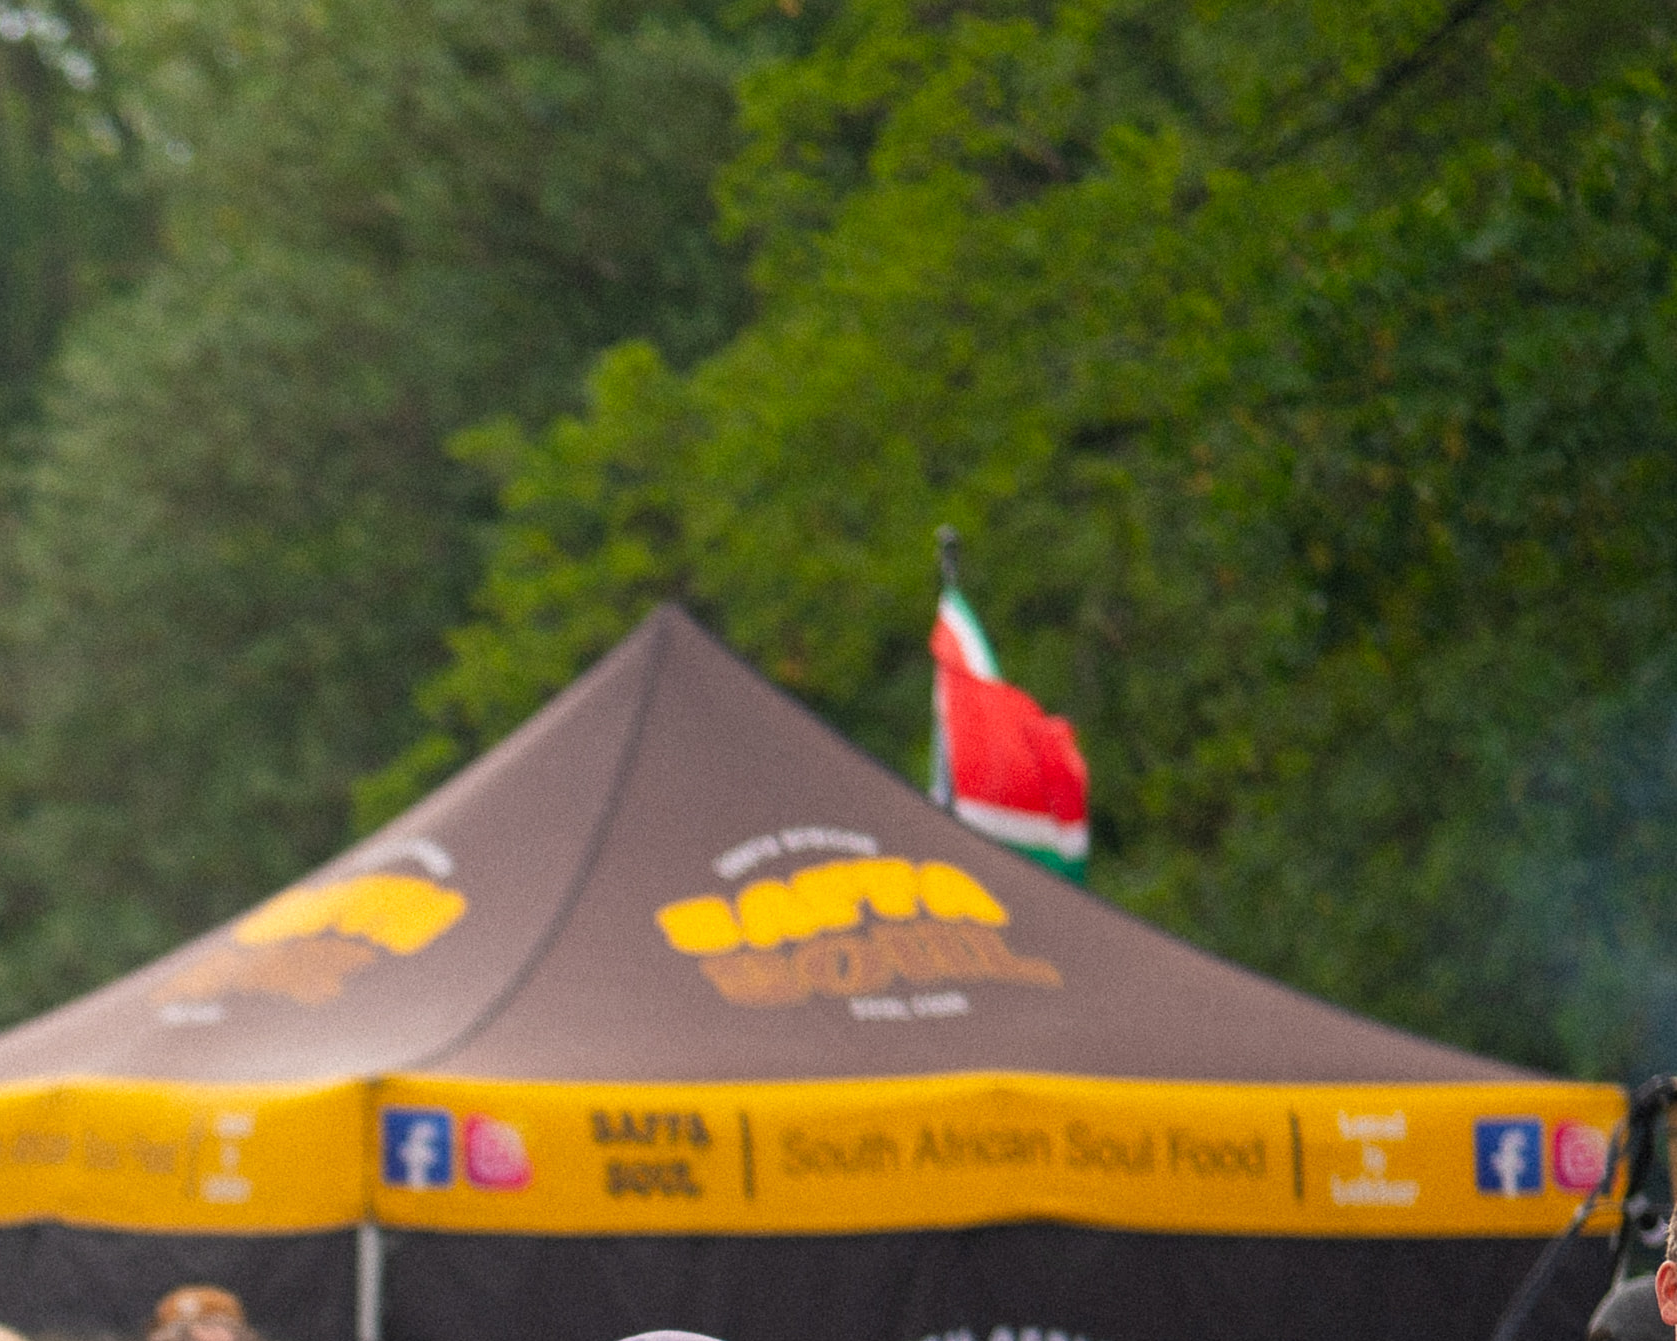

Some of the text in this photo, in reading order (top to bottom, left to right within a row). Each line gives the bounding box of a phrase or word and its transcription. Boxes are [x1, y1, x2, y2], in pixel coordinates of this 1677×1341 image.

[781, 1117, 1266, 1178] South African Soul Food
